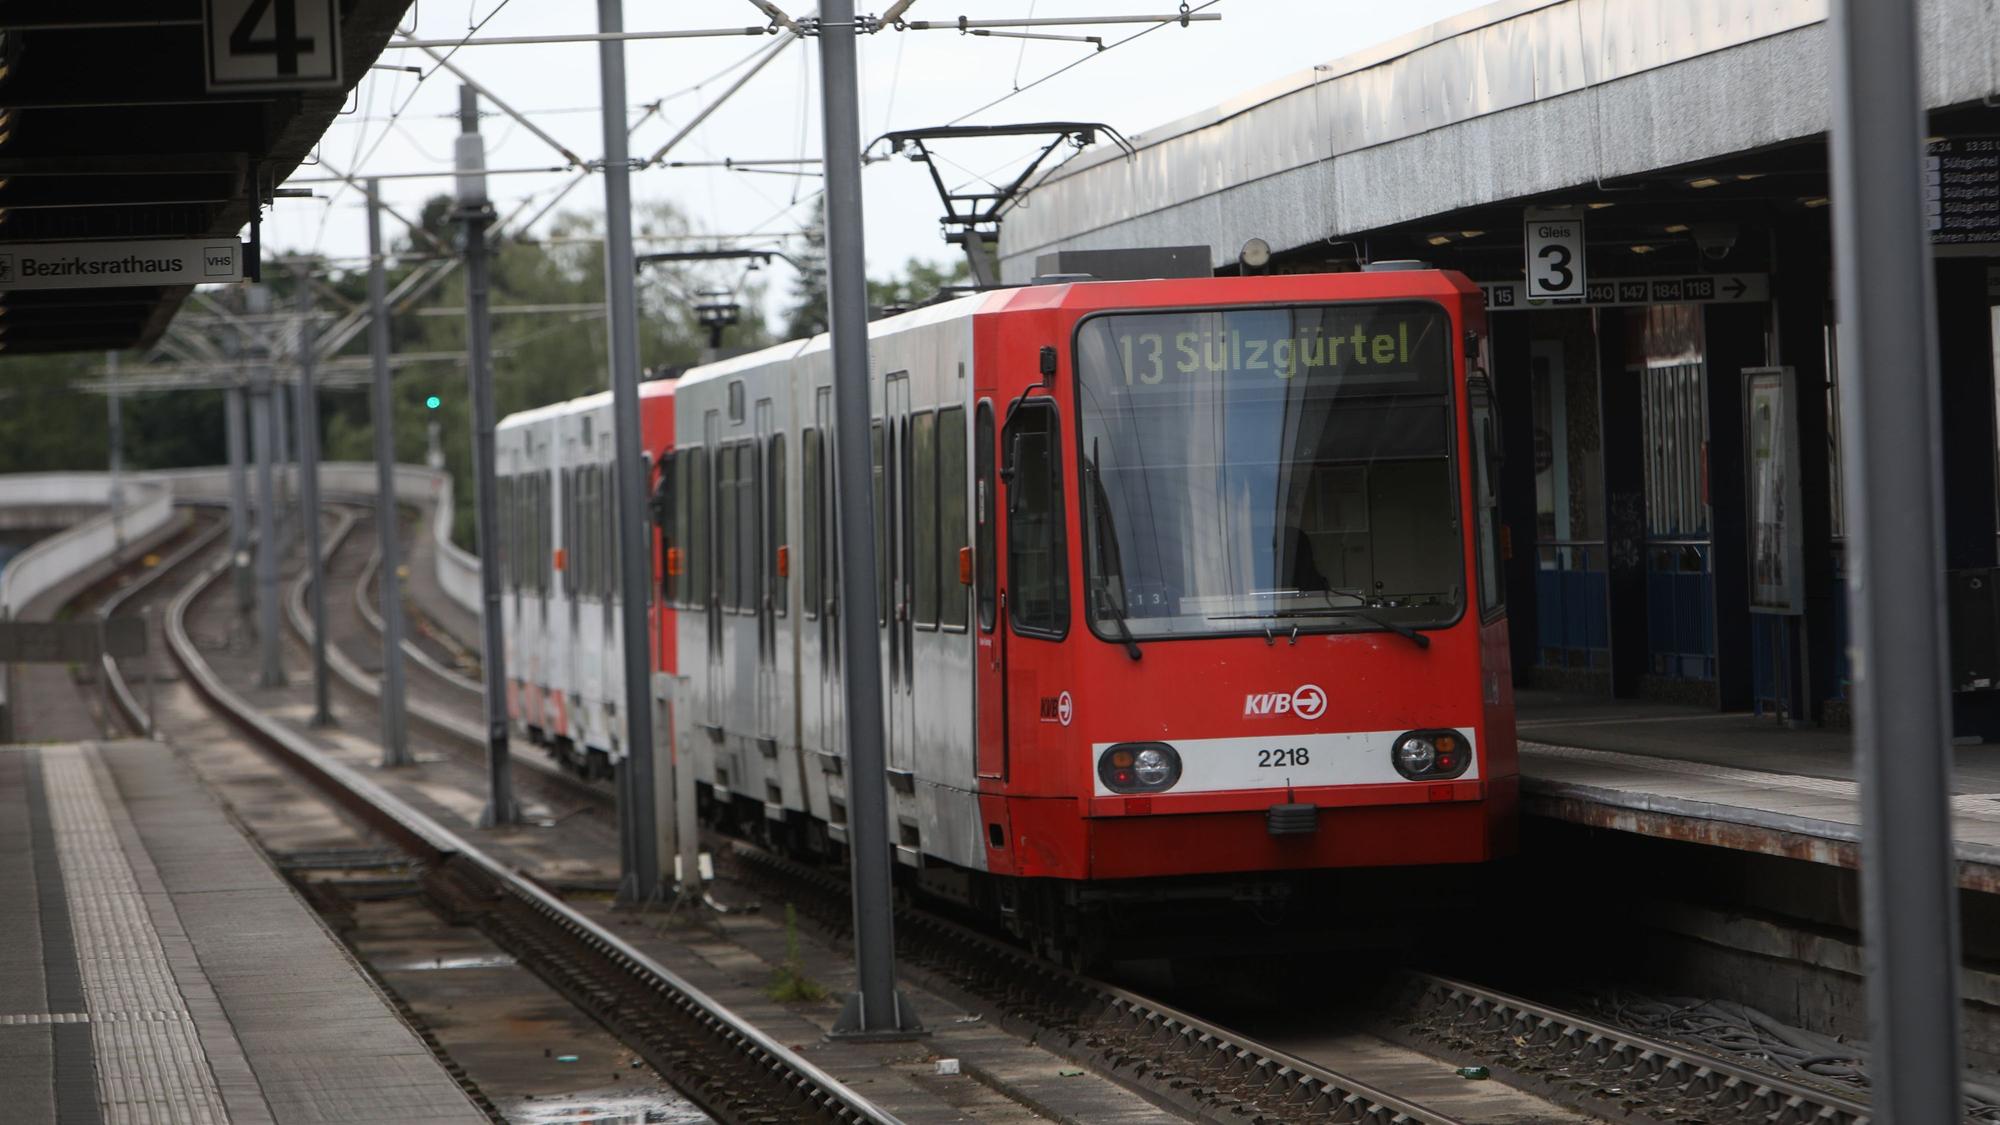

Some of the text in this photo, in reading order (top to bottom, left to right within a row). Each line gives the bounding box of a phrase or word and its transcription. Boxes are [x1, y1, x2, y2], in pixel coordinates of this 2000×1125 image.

[230, 0, 315, 75] 4
[1538, 226, 1571, 239] Gleis
[21, 255, 231, 277] Bezirksrathaus VHS
[1537, 244, 1574, 292] 3
[1495, 289, 1512, 303] 15
[1588, 285, 1614, 300] 140
[1621, 284, 1645, 299] 147
[1654, 282, 1680, 298] 184
[1686, 280, 1711, 295] 118
[1119, 321, 1409, 386] 13 Sülzgürtel
[1244, 693, 1292, 715] KVB
[1258, 747, 1310, 768] 2218
